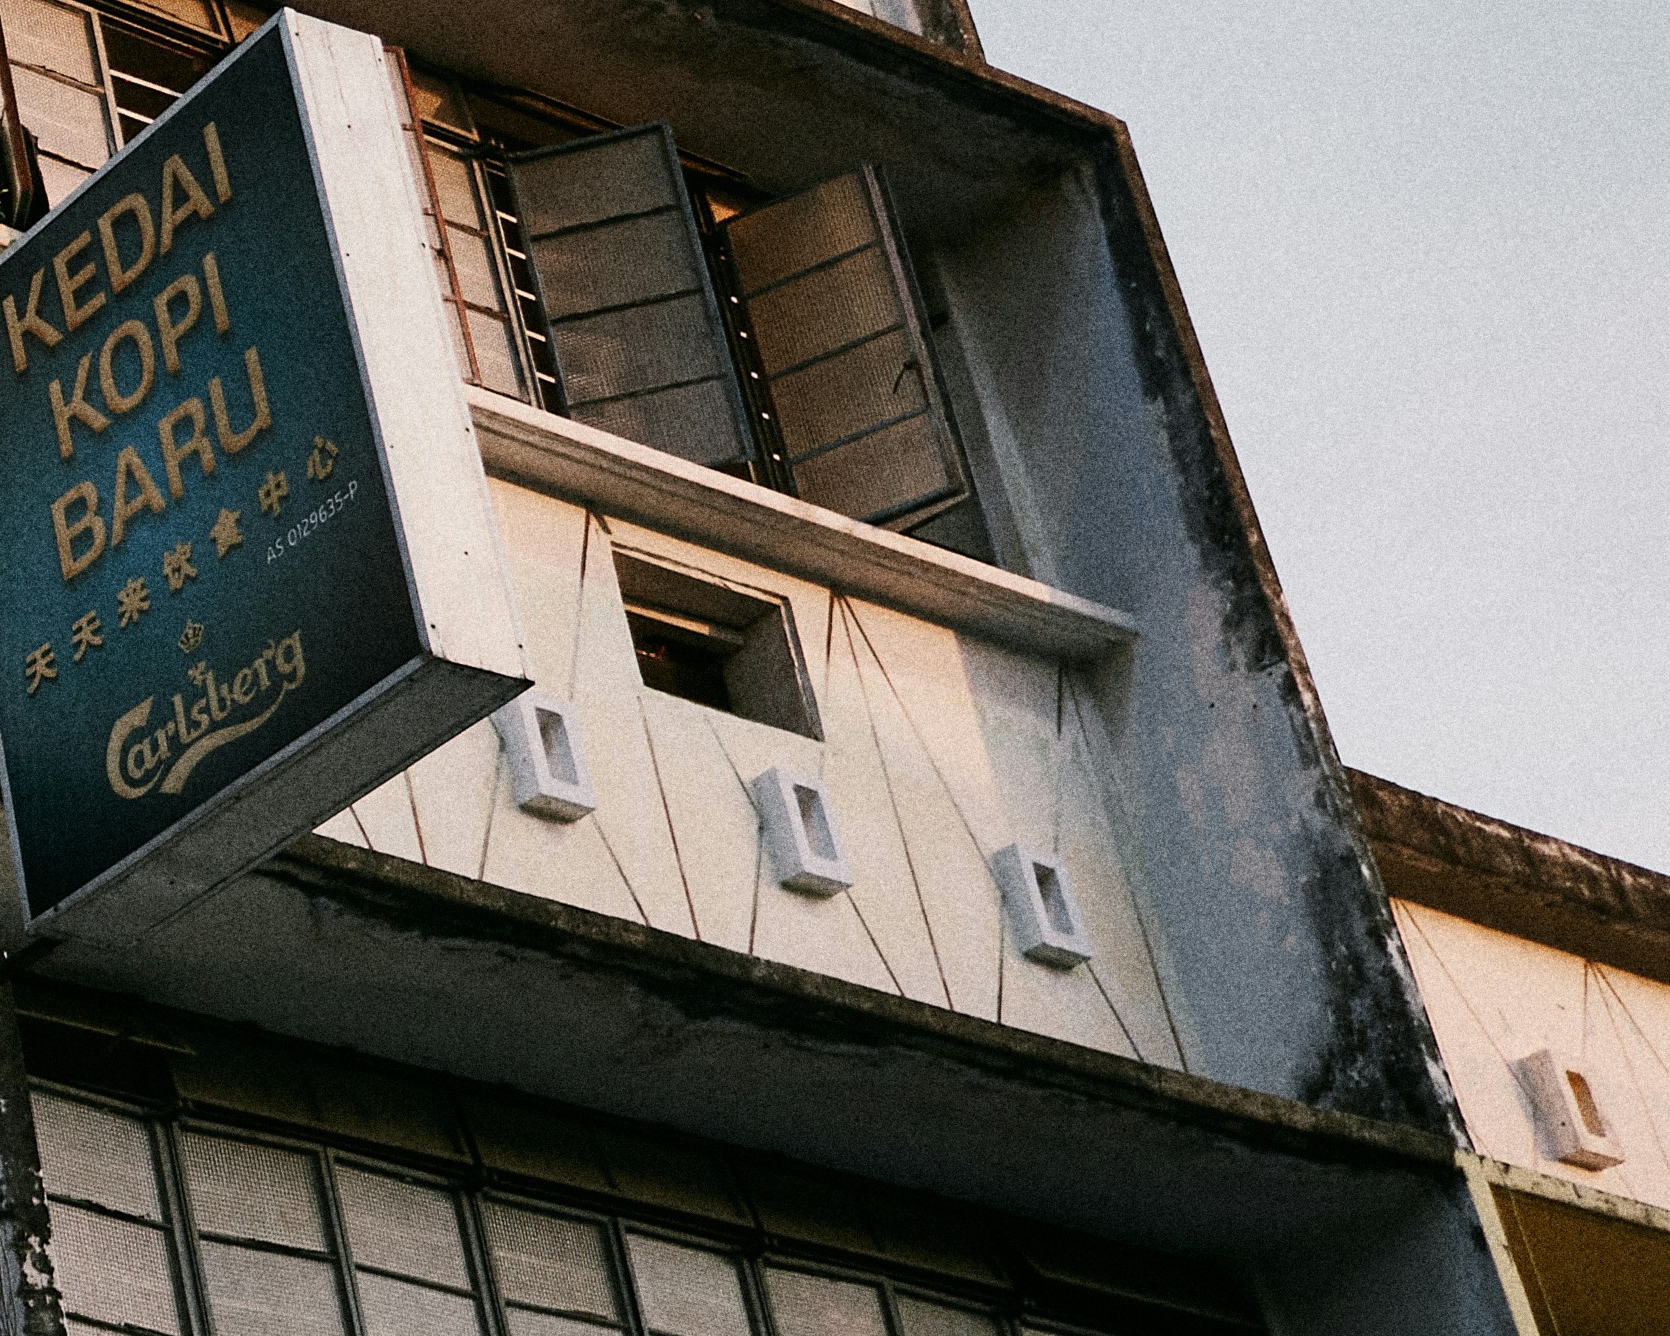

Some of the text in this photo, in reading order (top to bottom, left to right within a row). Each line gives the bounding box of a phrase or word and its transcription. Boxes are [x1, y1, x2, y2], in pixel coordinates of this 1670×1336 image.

[1, 120, 236, 374] KEDAI
[48, 251, 232, 460] KOPI
[24, 433, 340, 697] 天天来饮食中心
[51, 346, 272, 582] BARU
[266, 479, 359, 566] AS 0129635-P
[106, 626, 307, 800] Carlsberg
